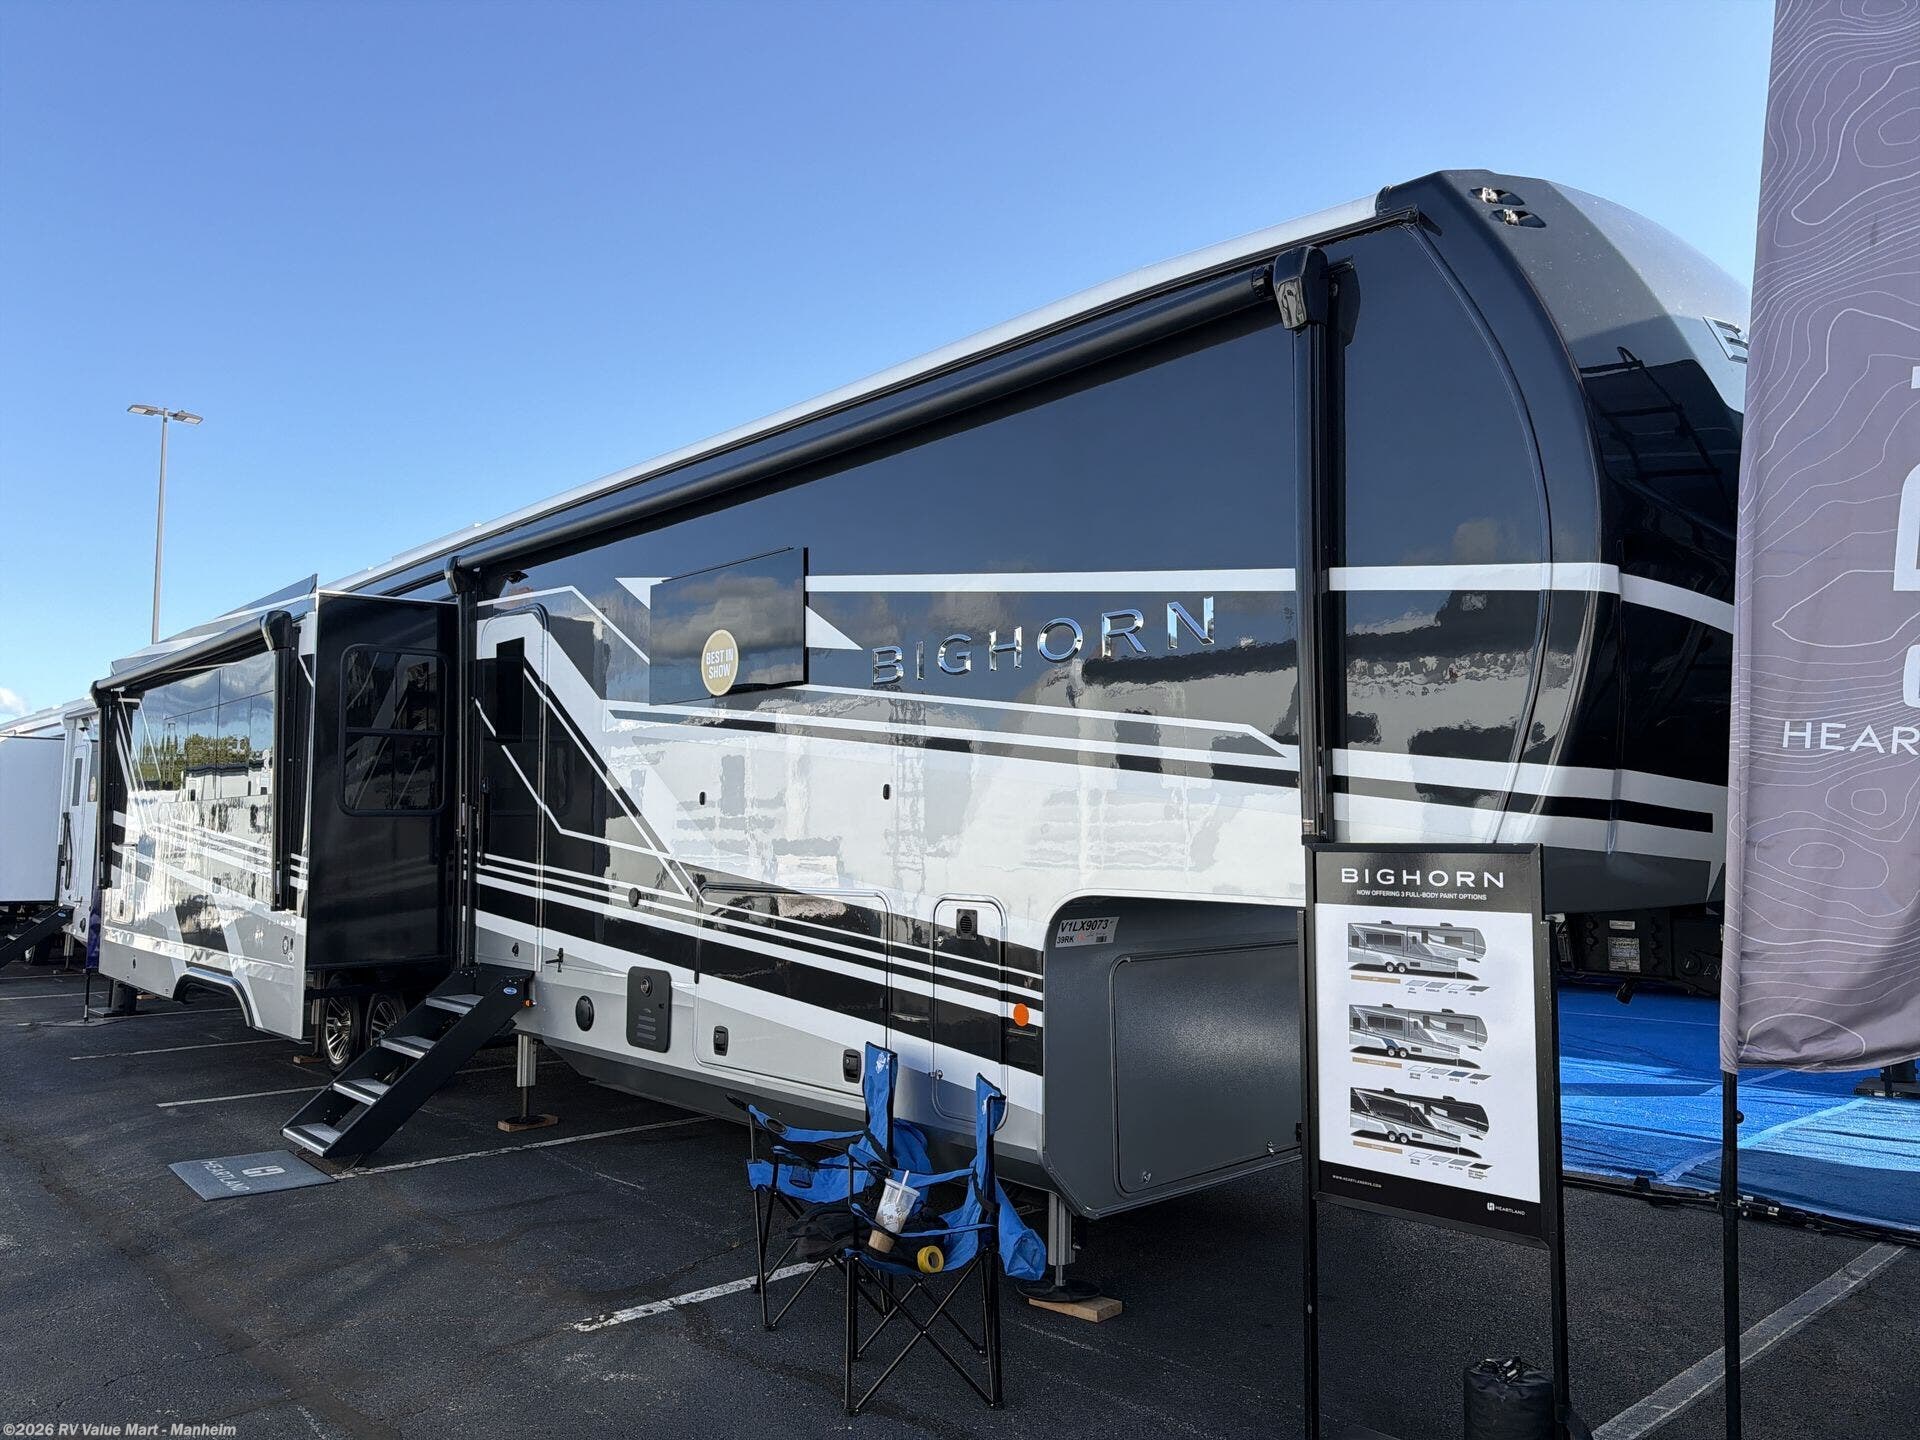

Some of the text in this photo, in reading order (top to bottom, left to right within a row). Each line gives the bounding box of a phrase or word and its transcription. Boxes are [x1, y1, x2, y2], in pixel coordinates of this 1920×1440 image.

[872, 596, 1215, 685] BIGHORN
[706, 648, 734, 665] BEST IN
[708, 663, 731, 679] SHOW
[1782, 720, 1920, 755] HEAR
[1341, 868, 1504, 888] BIGHORN
[1405, 891, 1439, 899] FULL-BODY
[1458, 893, 1487, 901] OPTIONS
[1061, 919, 1109, 932] V1LX9073
